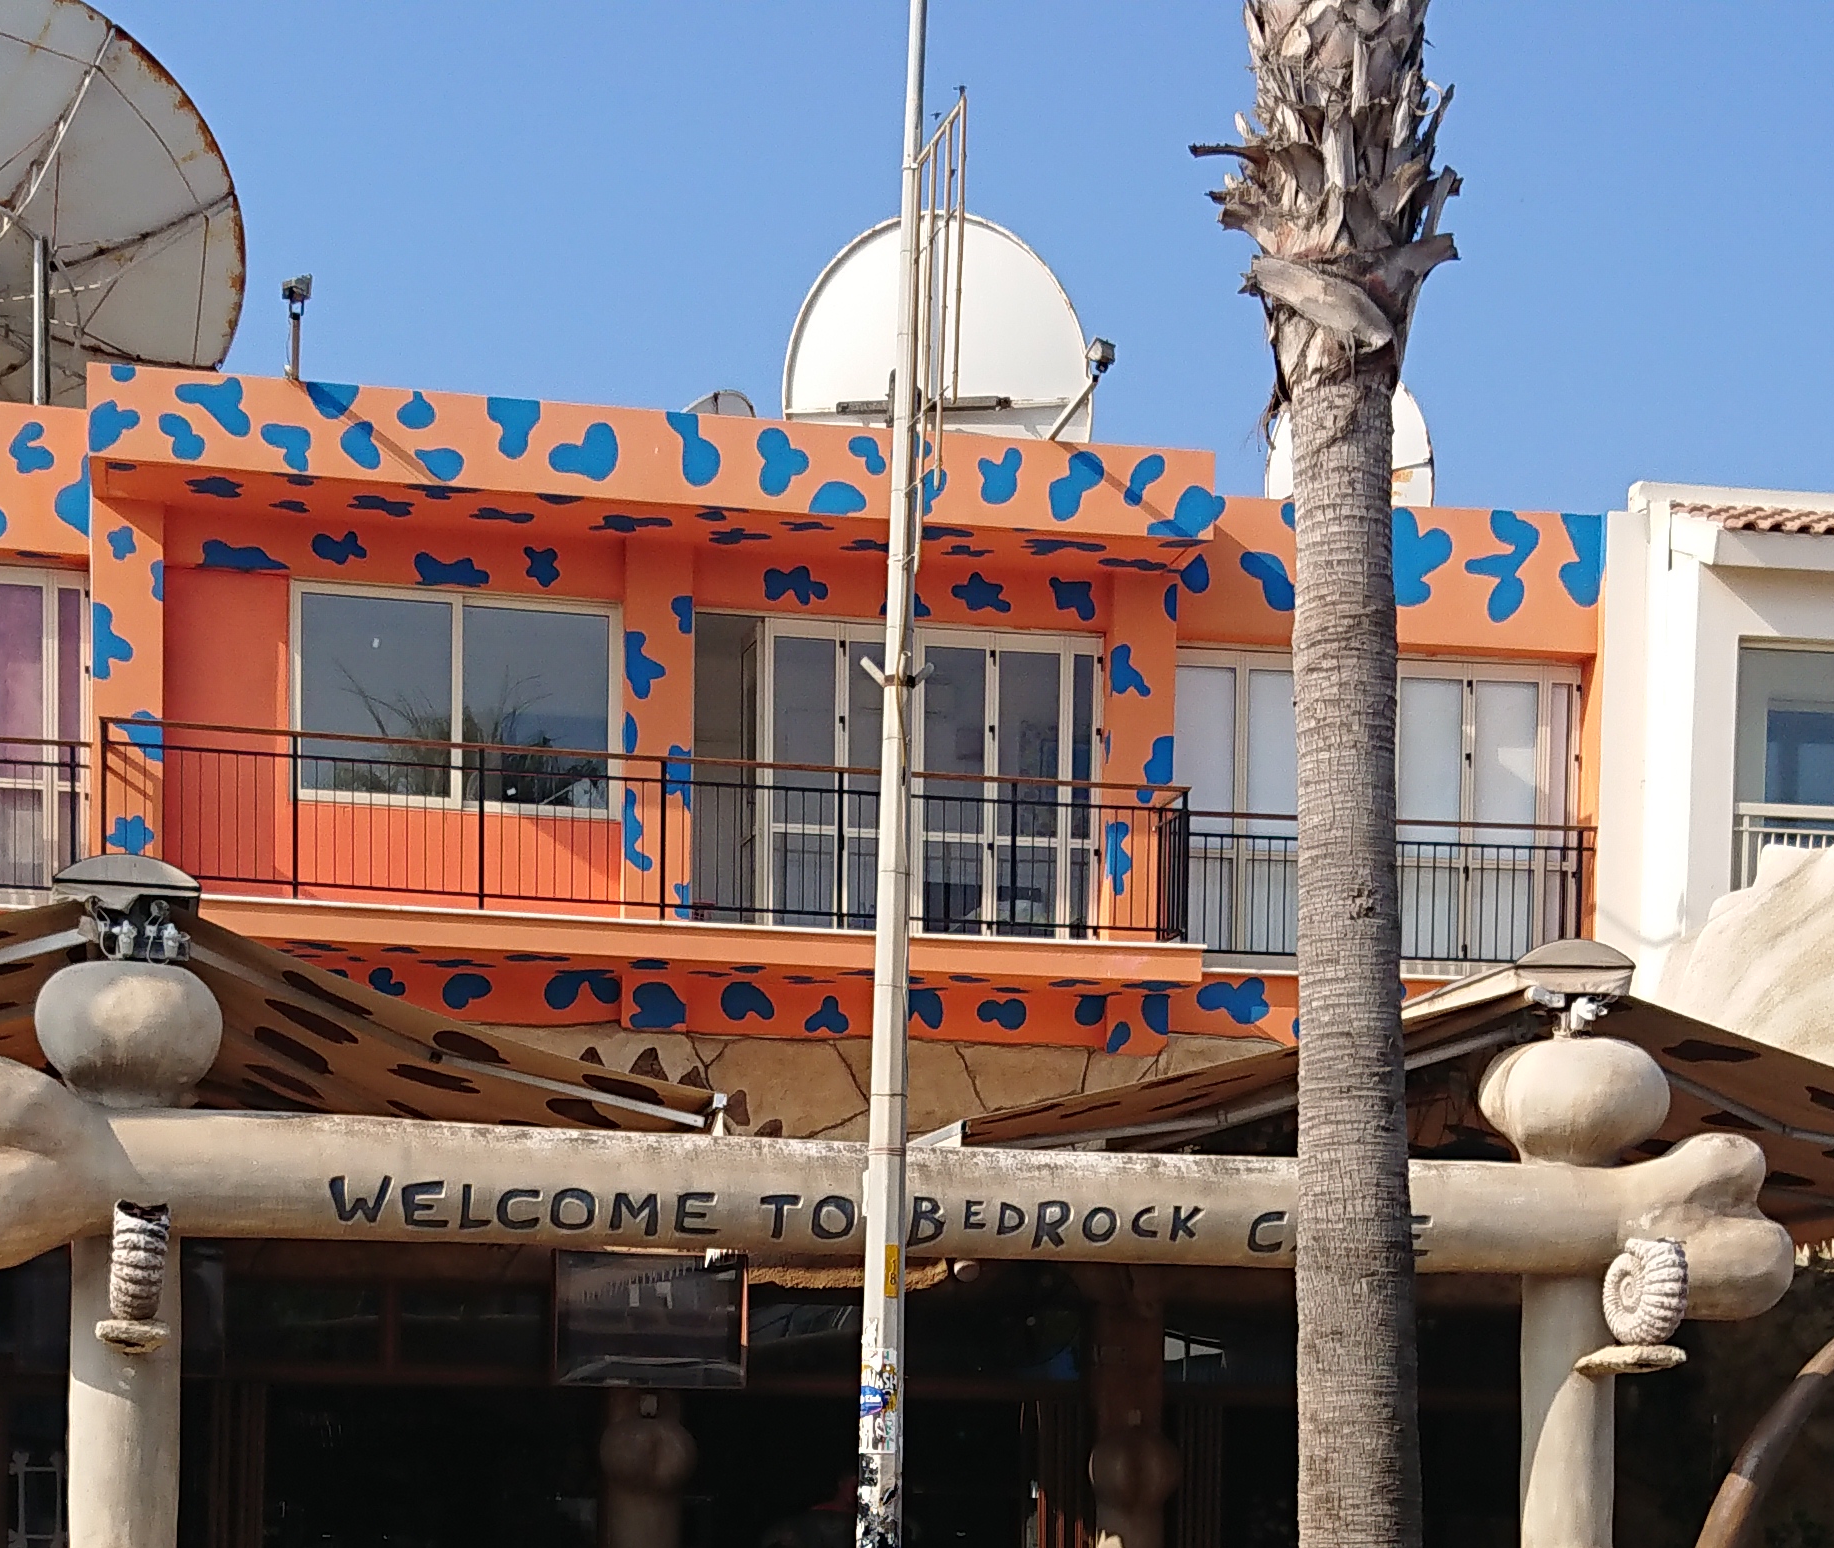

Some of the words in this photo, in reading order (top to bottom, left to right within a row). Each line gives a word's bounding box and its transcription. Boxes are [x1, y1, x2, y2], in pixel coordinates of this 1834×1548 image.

[328, 1174, 721, 1237] WELCOME
[760, 1194, 857, 1240] TO
[906, 1195, 1206, 1252] BEDROCK
